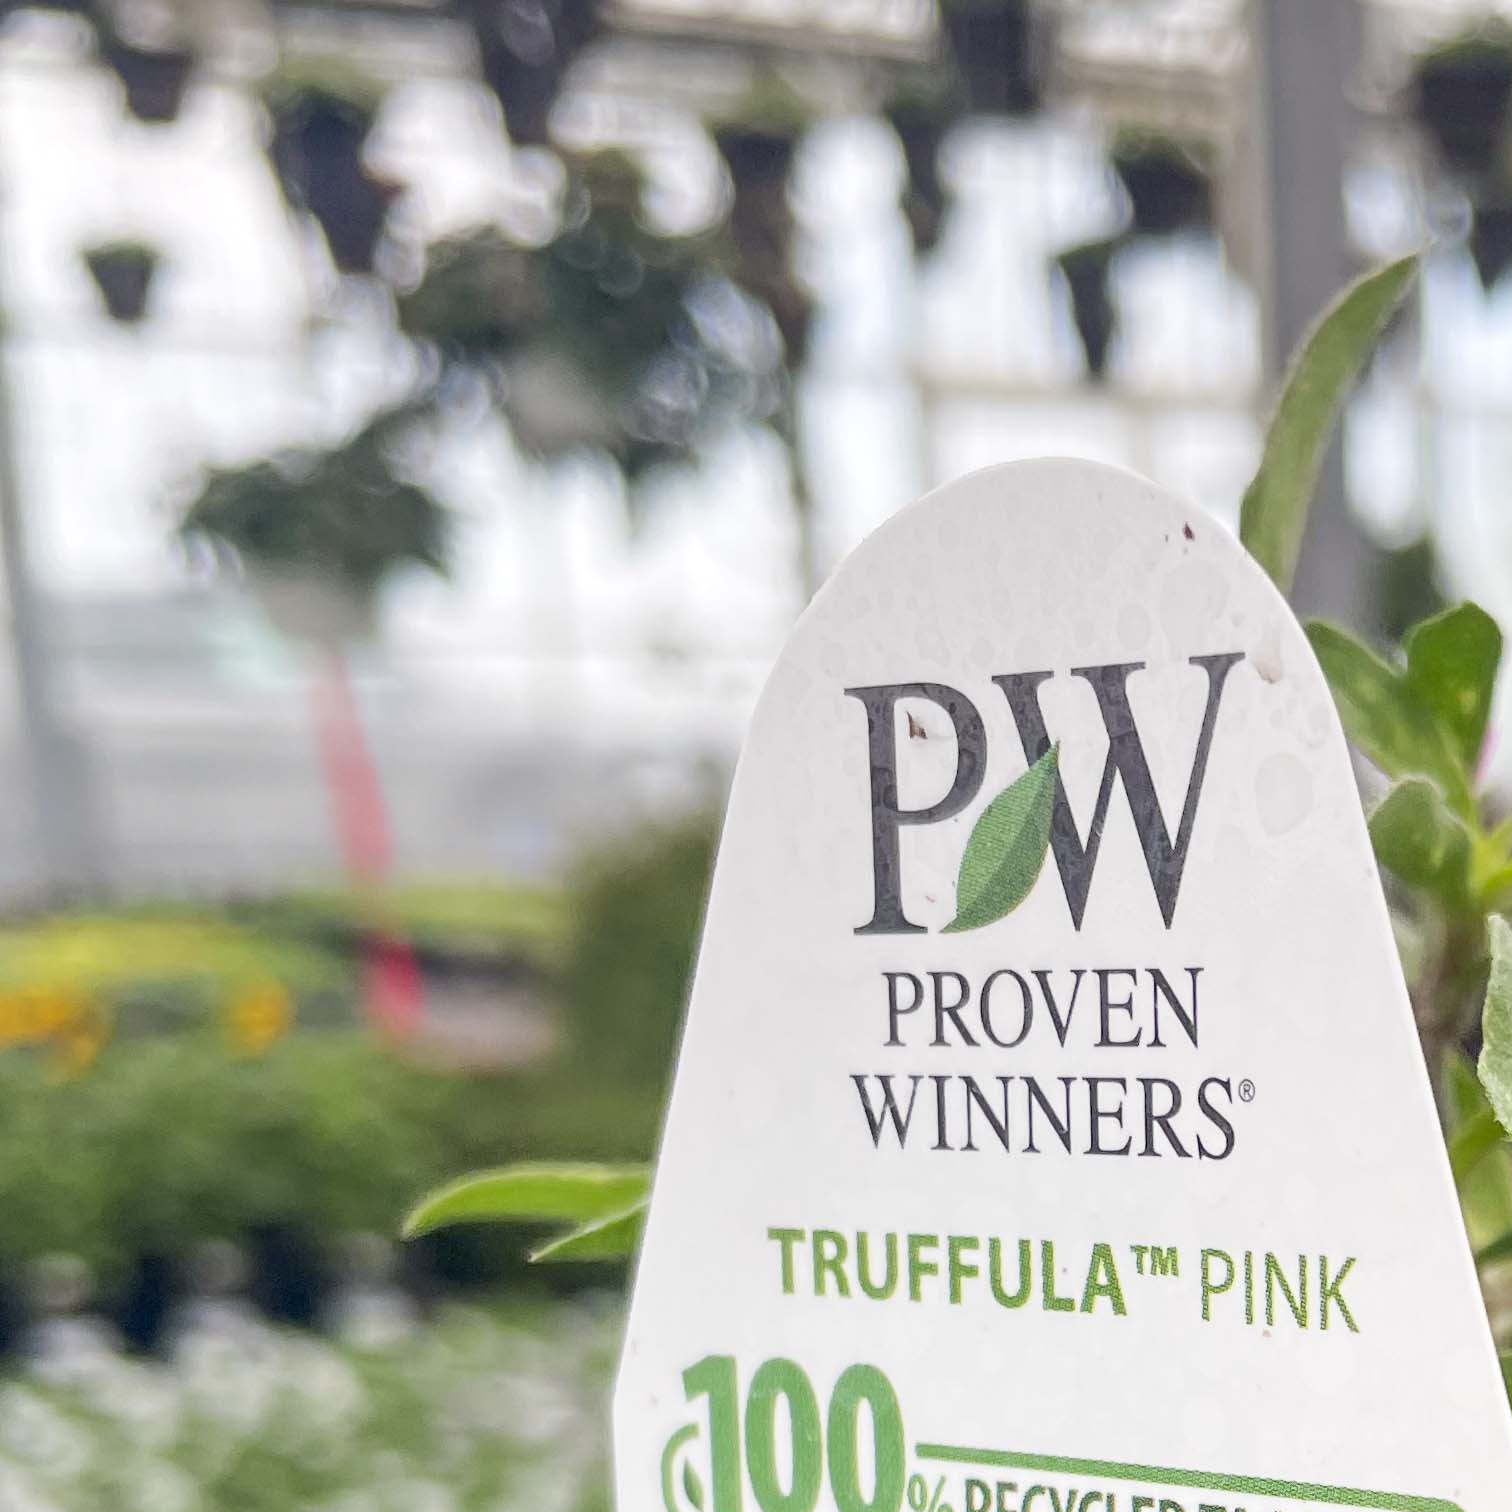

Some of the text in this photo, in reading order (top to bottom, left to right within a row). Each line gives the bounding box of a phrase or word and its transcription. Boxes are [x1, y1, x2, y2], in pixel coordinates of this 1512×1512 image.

[844, 652, 1245, 936] PW
[881, 967, 1204, 1049] PROVEN
[1200, 1248, 1361, 1334] PINK
